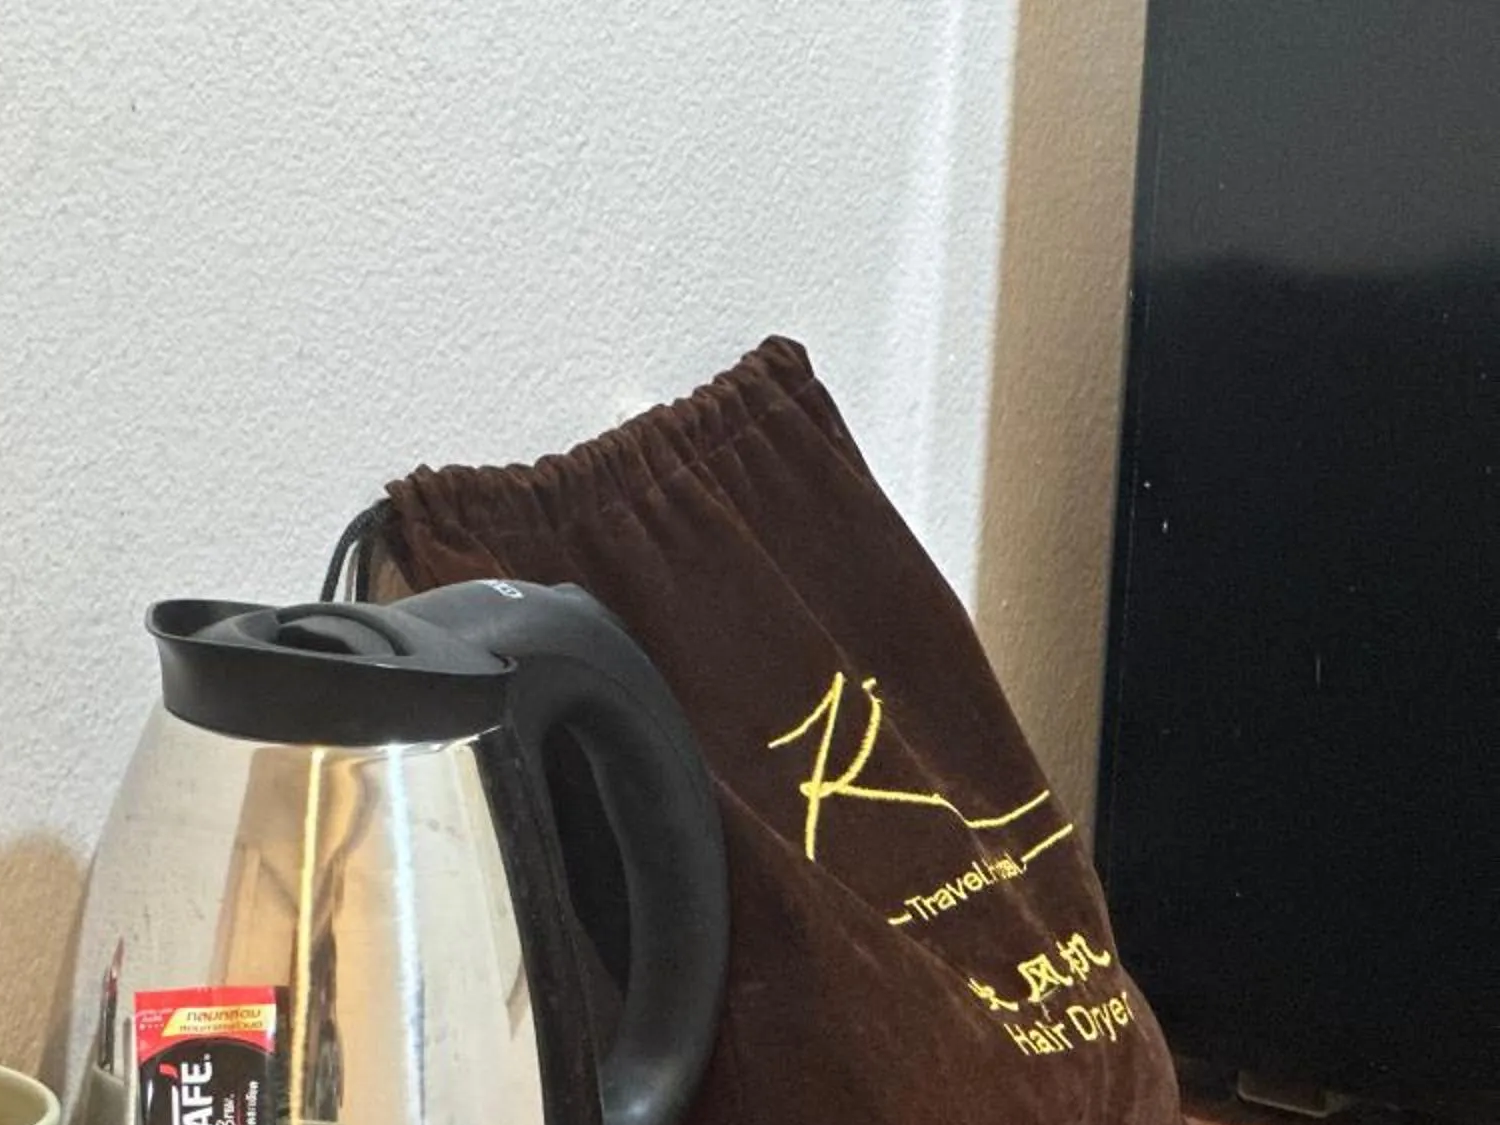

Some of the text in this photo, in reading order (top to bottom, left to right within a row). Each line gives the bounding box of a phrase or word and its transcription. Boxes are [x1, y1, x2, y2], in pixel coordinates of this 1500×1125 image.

[904, 860, 990, 921] Travel
[1004, 991, 1134, 1056] Hair Dryer
